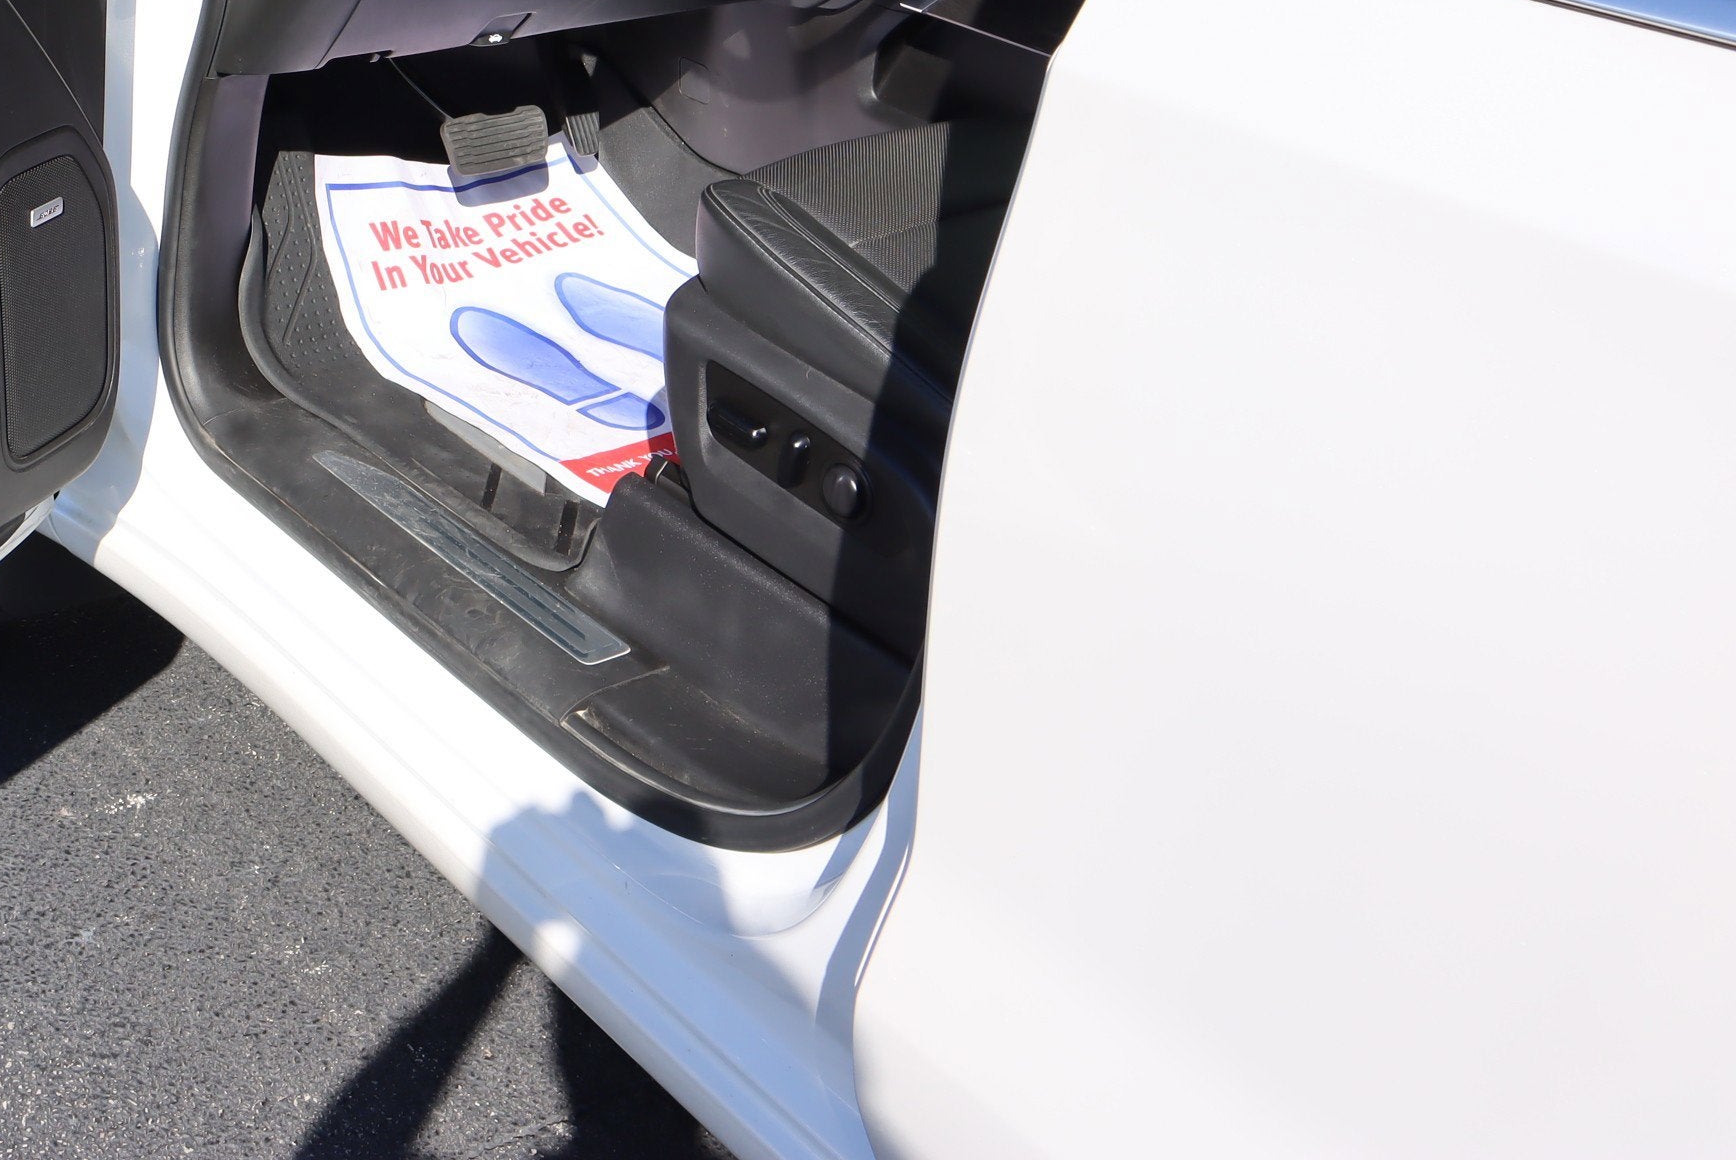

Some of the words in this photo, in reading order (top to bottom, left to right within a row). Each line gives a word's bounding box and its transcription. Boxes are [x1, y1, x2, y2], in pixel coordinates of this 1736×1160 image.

[369, 220, 421, 251] We
[420, 219, 484, 249] Take
[483, 198, 572, 237] Pride
[371, 260, 407, 290] In
[409, 254, 474, 284] Your
[471, 213, 604, 268] Vehicle!
[586, 458, 642, 477] THANK
